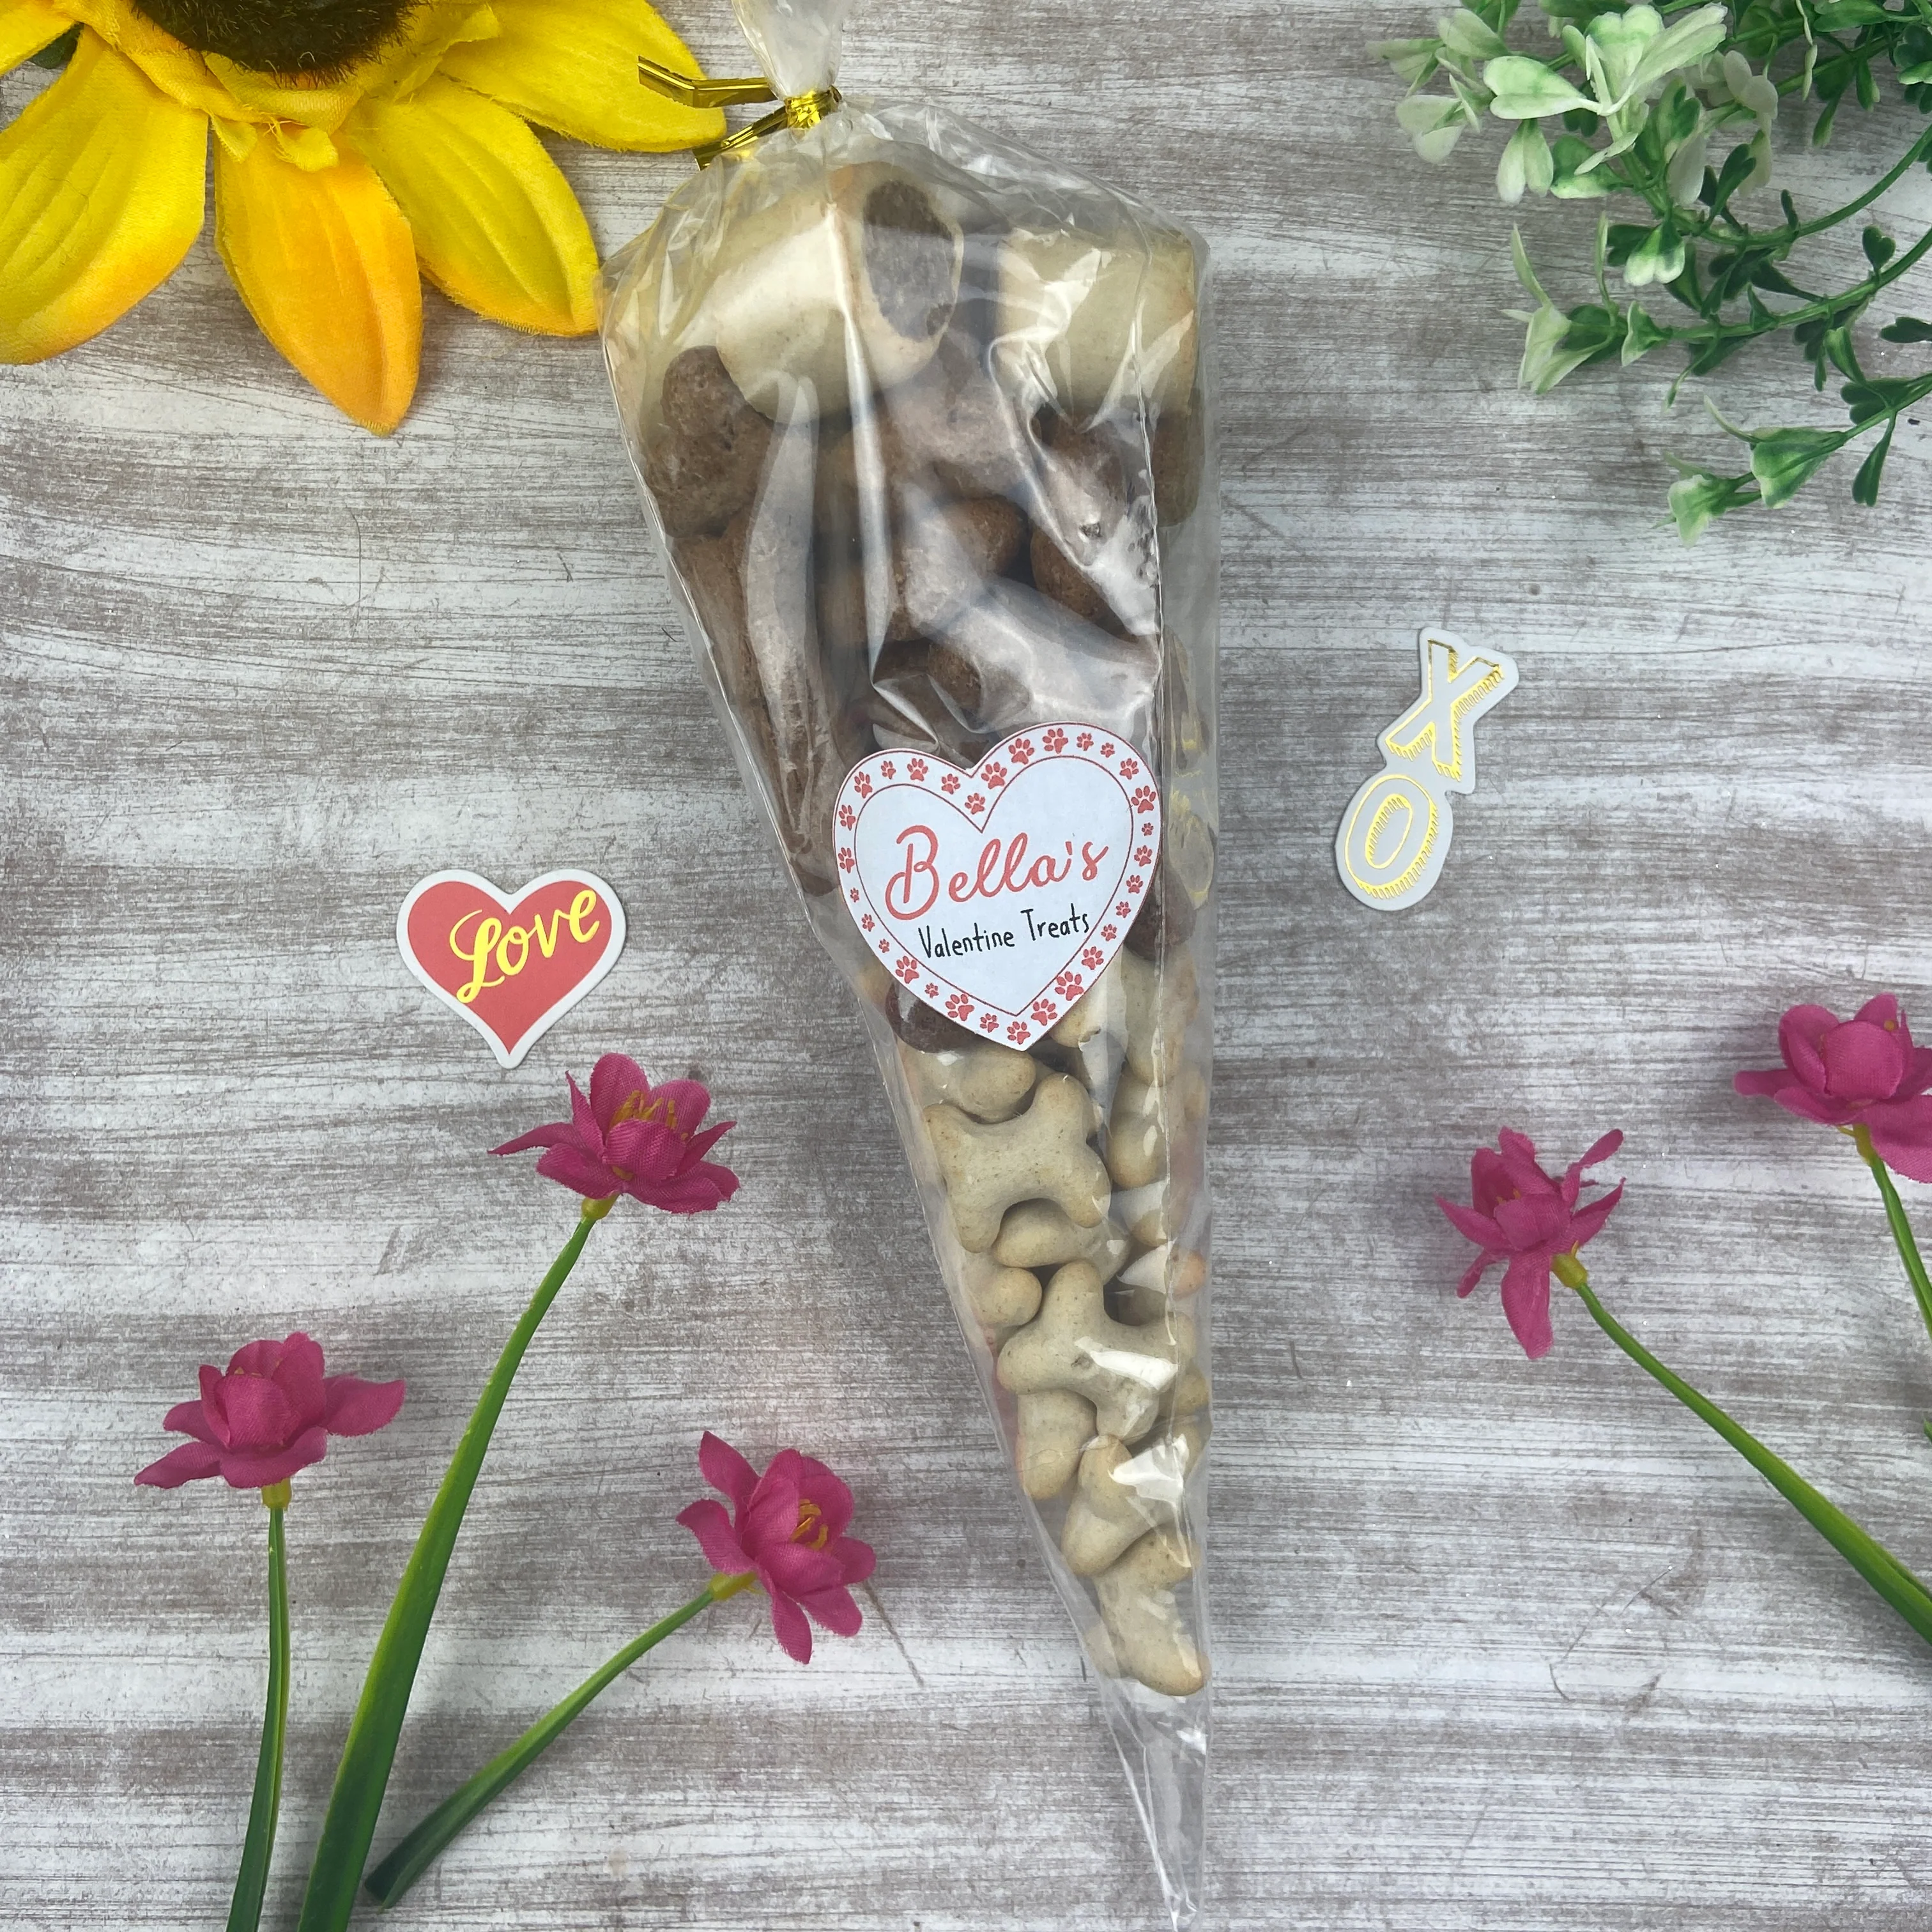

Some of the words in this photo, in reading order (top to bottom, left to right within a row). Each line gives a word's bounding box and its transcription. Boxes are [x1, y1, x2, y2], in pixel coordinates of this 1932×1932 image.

[885, 825, 1109, 921] Bella's
[449, 889, 600, 1004] Love
[919, 922, 1015, 959] Valentine
[1020, 903, 1090, 942] Treats
